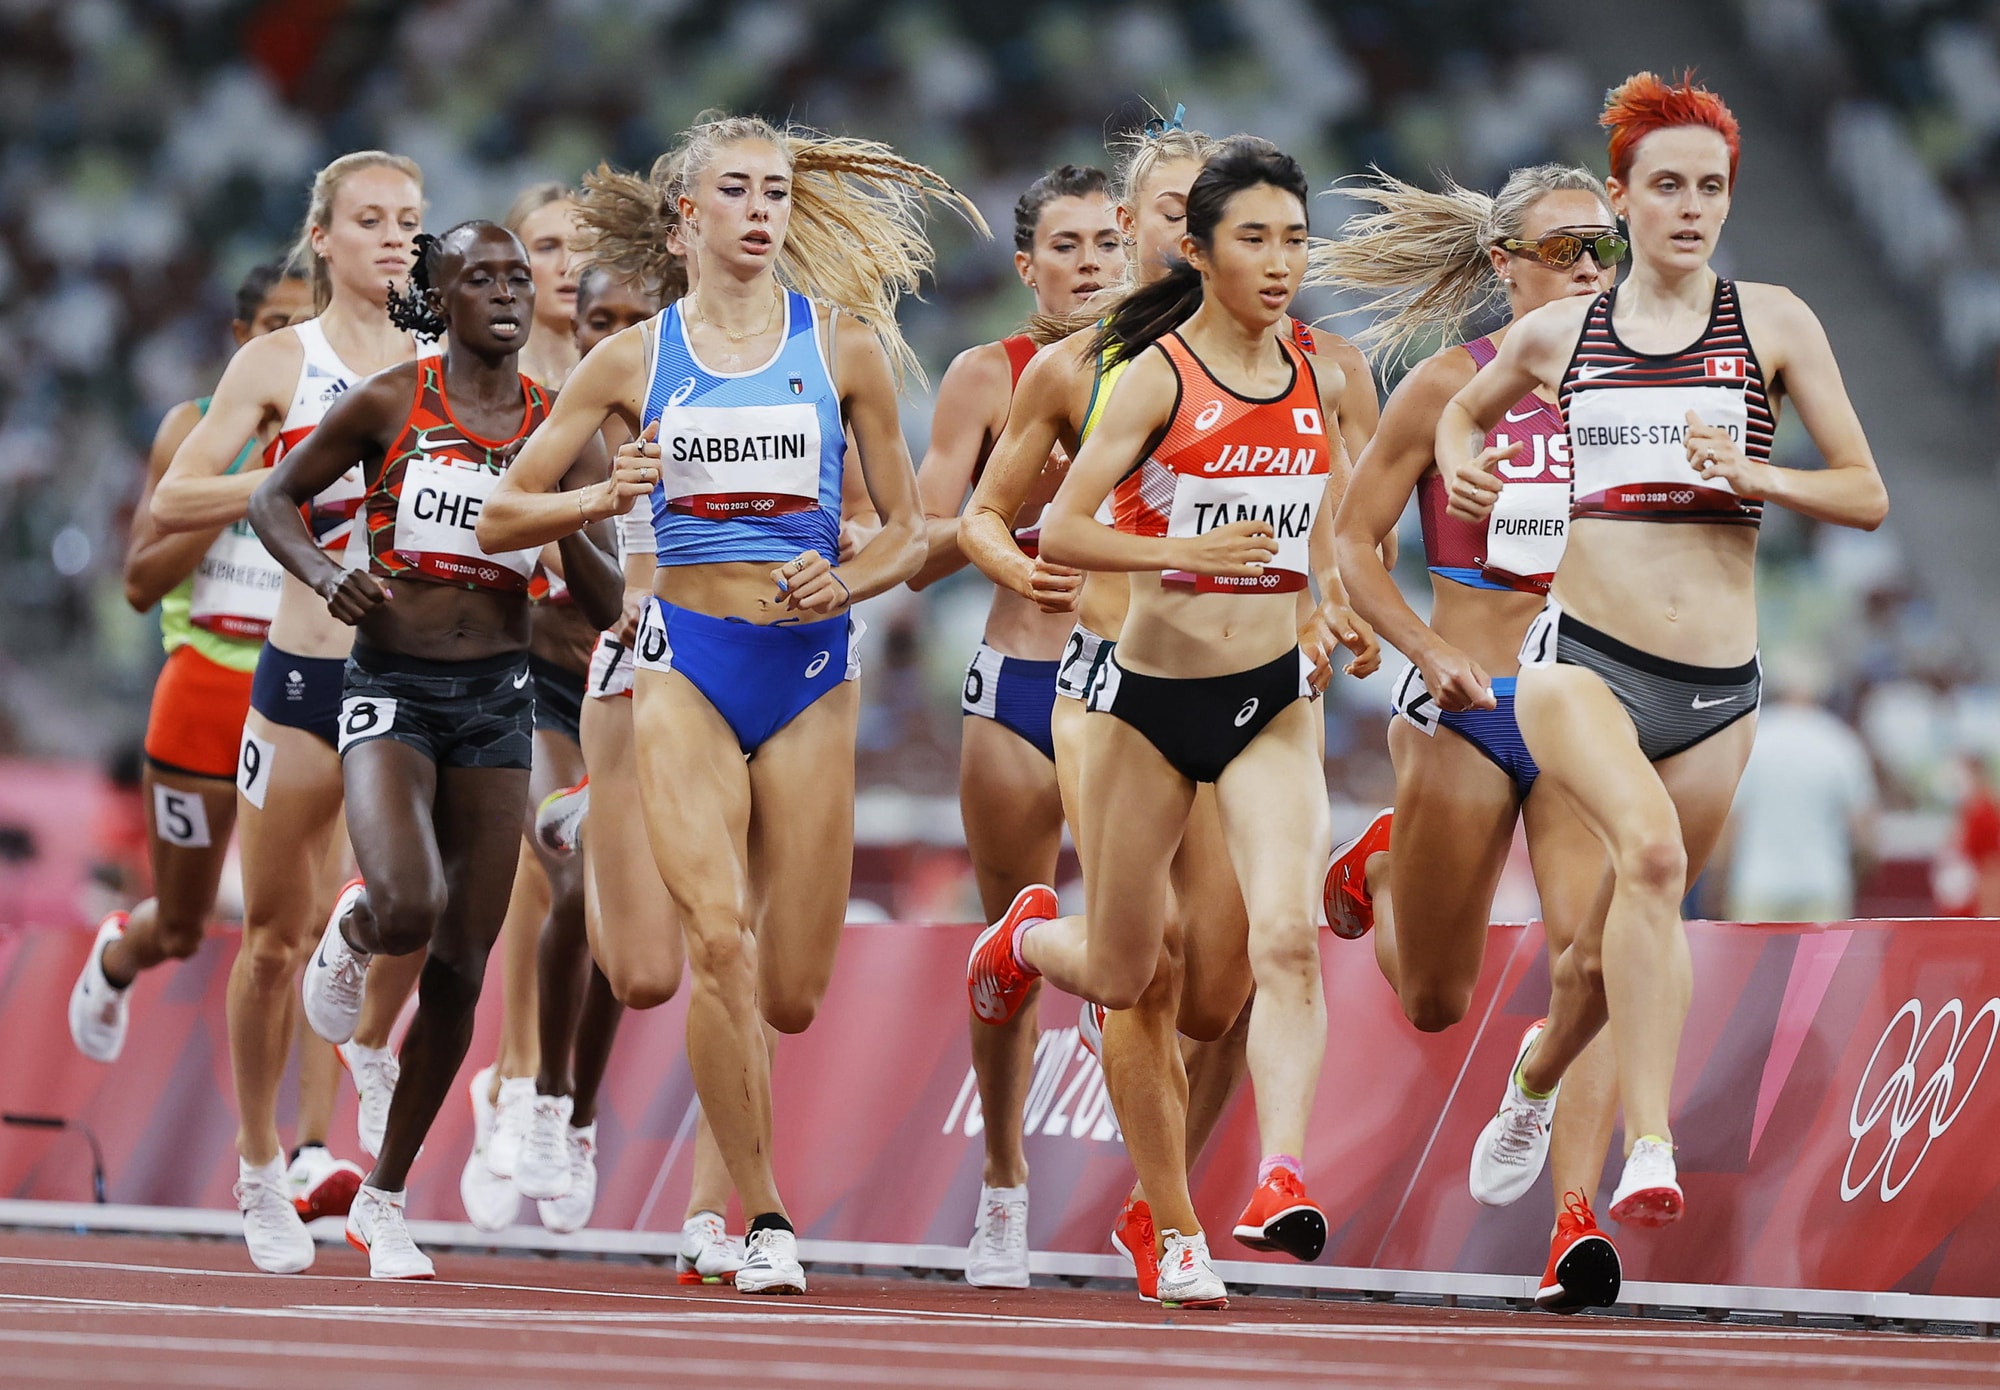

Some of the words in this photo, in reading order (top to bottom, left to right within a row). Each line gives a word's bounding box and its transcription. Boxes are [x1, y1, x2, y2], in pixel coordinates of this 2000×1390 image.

[672, 433, 806, 463] SABBATINI
[1577, 425, 1739, 446] DEBUES-STAD
[1203, 444, 1317, 475] JAPAN
[705, 501, 730, 511] TOKYO
[730, 501, 750, 510] 2020
[1620, 493, 1646, 503] TOKYO
[1647, 493, 1668, 502] 2020
[1494, 518, 1565, 537] PURRIER
[434, 559, 459, 572] TOKYO
[458, 564, 477, 575] 2020
[1213, 575, 1239, 586] TOKYO
[1239, 577, 1258, 586] 2020
[598, 638, 626, 692] 7
[1057, 631, 1084, 691] 2
[345, 701, 378, 735] 8
[243, 739, 261, 791] 9
[166, 795, 193, 840] 5
